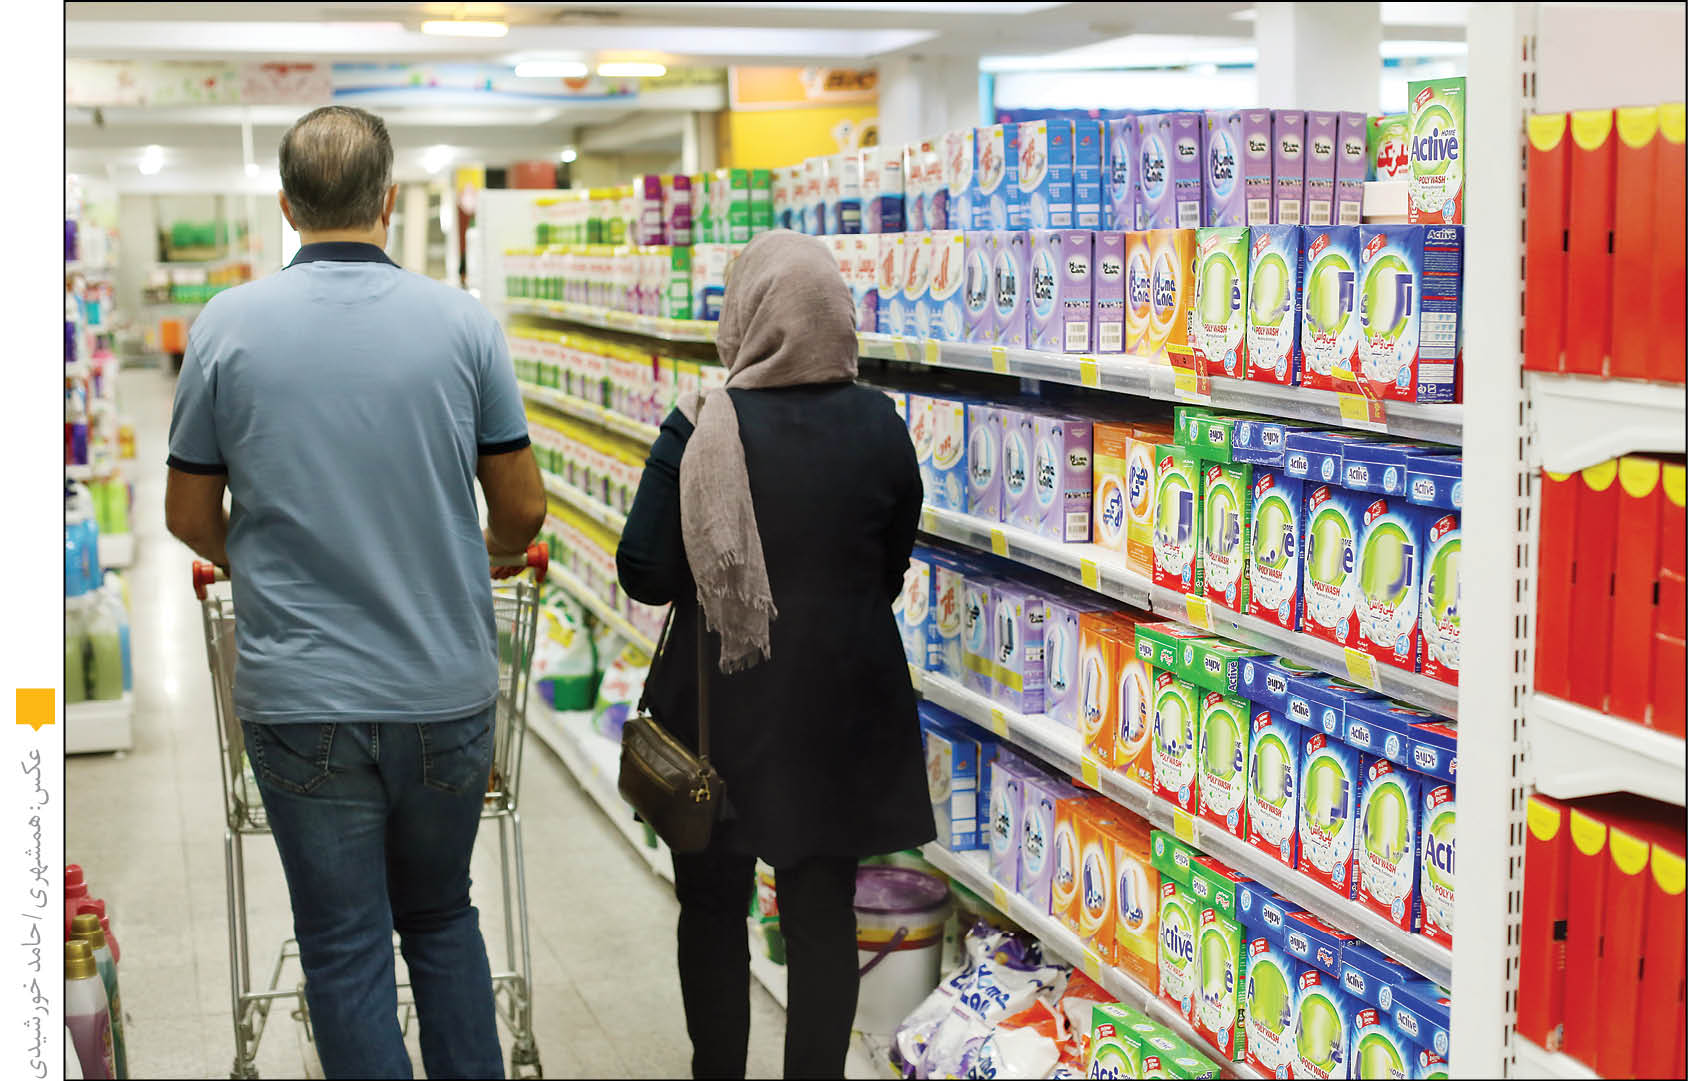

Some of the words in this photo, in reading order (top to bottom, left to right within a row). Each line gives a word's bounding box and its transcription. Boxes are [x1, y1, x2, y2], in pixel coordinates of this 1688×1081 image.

[1410, 127, 1458, 161] Active
[1428, 229, 1456, 239] Active
[1153, 271, 1176, 291] Home
[1155, 290, 1174, 307] Care
[1290, 457, 1308, 471] Active
[1349, 467, 1367, 482] Active
[1414, 481, 1434, 496] Active
[1228, 661, 1237, 692] Active
[1292, 702, 1309, 717] Active
[1350, 727, 1369, 742] Active
[1415, 750, 1435, 767] Active
[1160, 921, 1193, 962] Active
[1346, 973, 1363, 991] Active
[1398, 1012, 1417, 1032] Active
